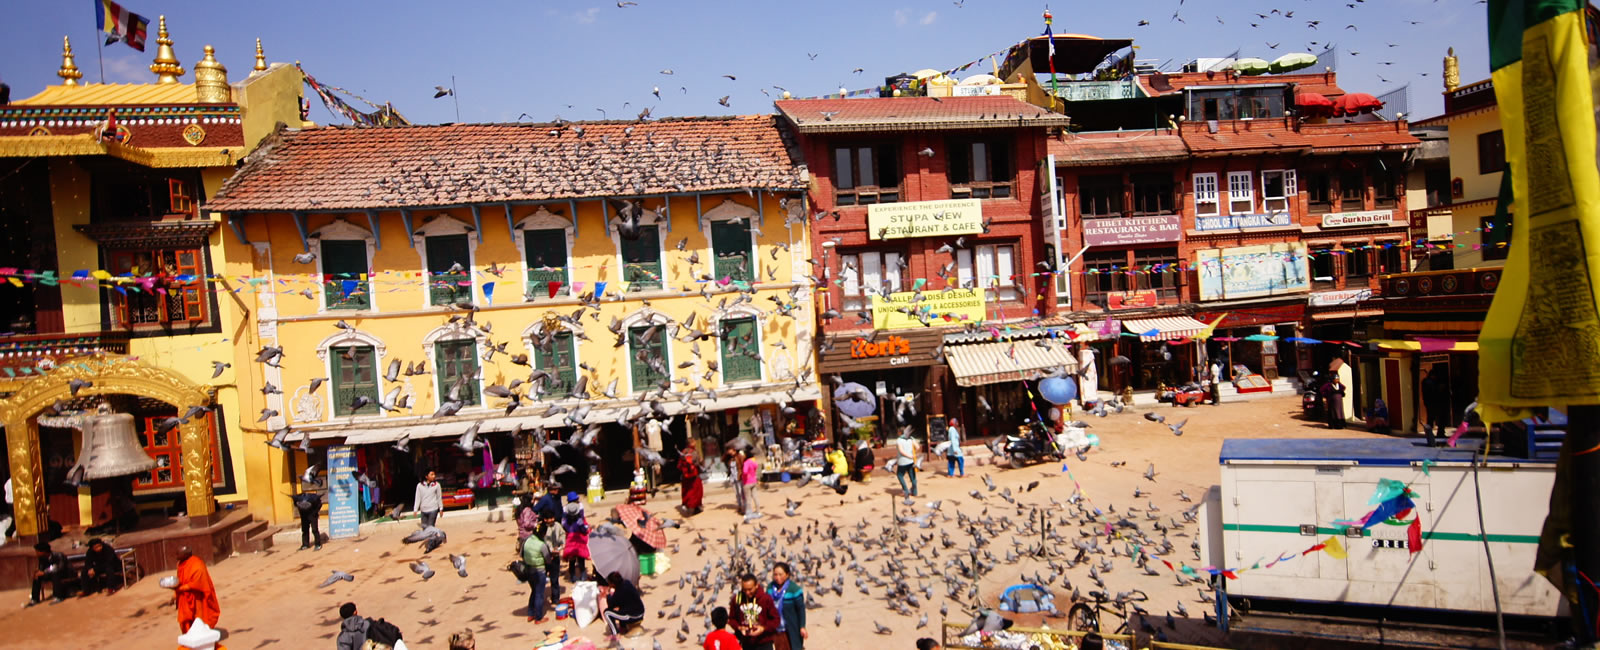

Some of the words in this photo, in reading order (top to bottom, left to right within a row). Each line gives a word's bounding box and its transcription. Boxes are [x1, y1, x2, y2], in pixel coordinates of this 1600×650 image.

[890, 214, 929, 223] STUPA
[932, 212, 962, 221] VEW
[1125, 217, 1168, 226] KITCHEN
[1197, 217, 1221, 229] SCHOOL
[1222, 217, 1231, 228] OF
[1232, 215, 1261, 228] THANGKA
[1261, 214, 1289, 226] PTING
[1342, 215, 1372, 223] Gurkha
[1373, 214, 1391, 222] Grill
[943, 224, 949, 232] &
[952, 222, 976, 231] CAFE
[1085, 225, 1147, 235] RESTAURANT
[948, 291, 977, 299] DESIGN
[940, 300, 981, 309] ACCESSORIES
[1372, 539, 1408, 549] GREE
